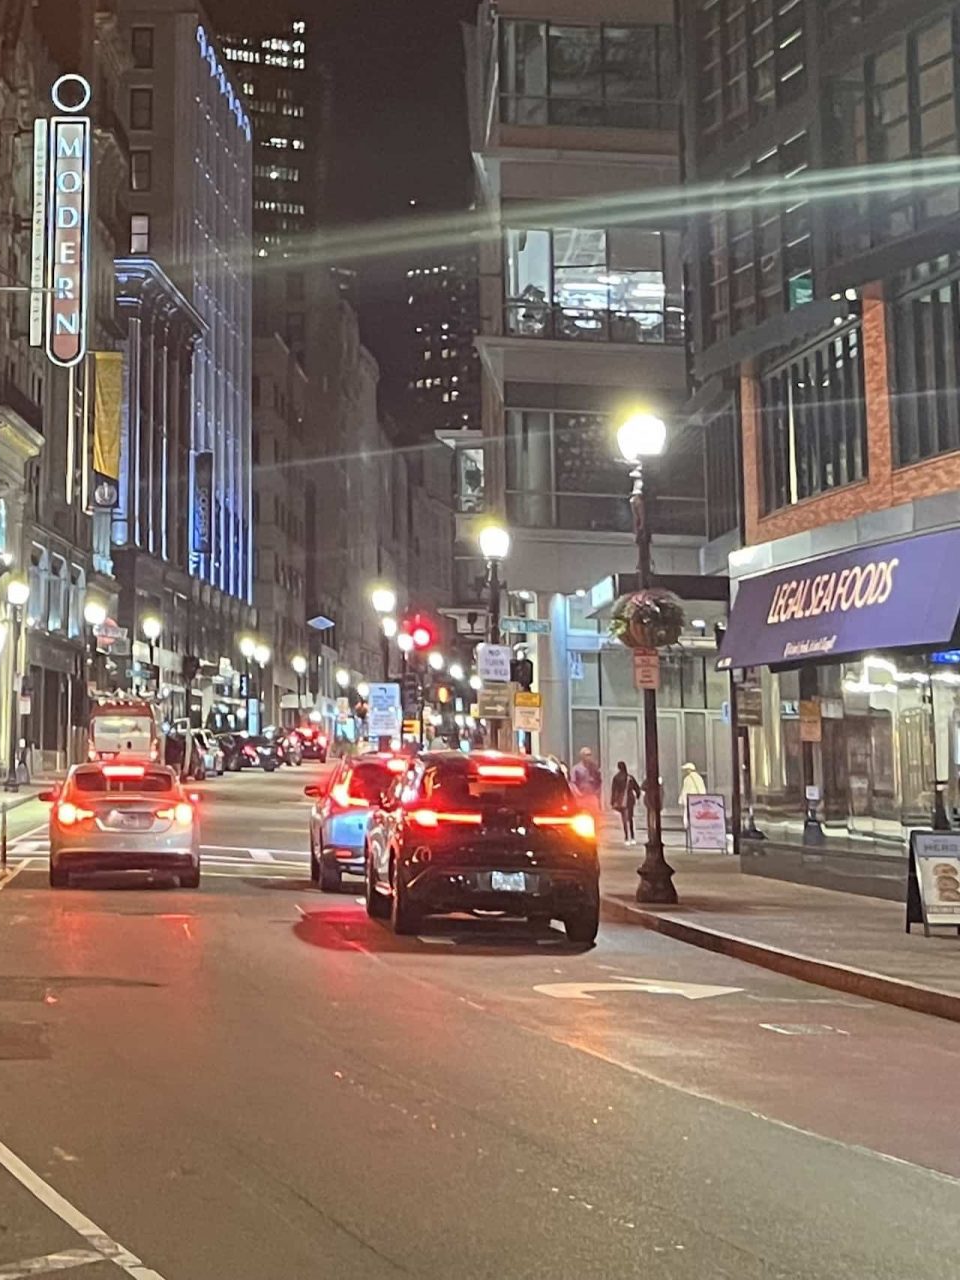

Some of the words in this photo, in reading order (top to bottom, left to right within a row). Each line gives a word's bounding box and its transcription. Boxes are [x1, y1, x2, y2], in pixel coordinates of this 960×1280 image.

[55, 135, 83, 335] MODERN
[33, 254, 41, 322] SUFOLK
[767, 578, 811, 624] LEGAL
[804, 572, 837, 618] SEA
[831, 558, 900, 611] FOODS
